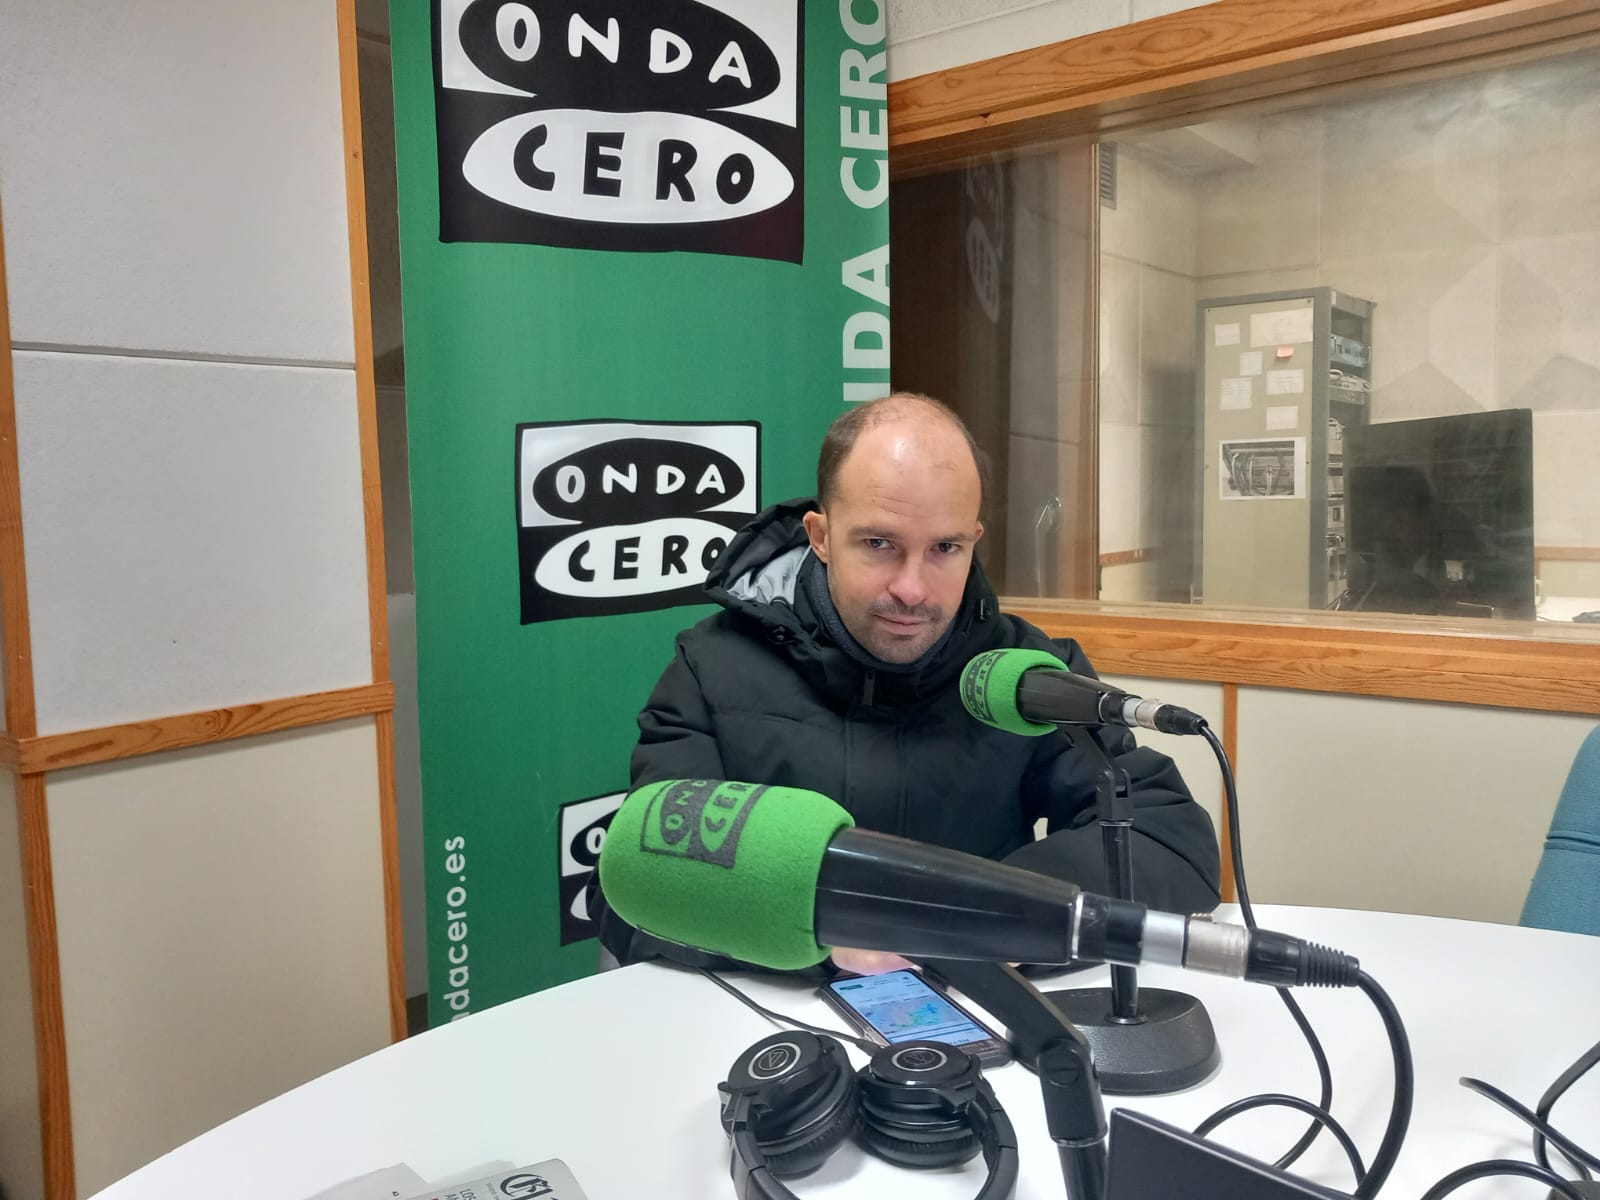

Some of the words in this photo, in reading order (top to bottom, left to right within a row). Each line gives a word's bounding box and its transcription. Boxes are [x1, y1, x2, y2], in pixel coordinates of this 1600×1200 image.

[495, 2, 752, 89] ONDA
[513, 123, 756, 205] CERO
[555, 463, 726, 503] ONDA
[568, 535, 728, 582] CERO
